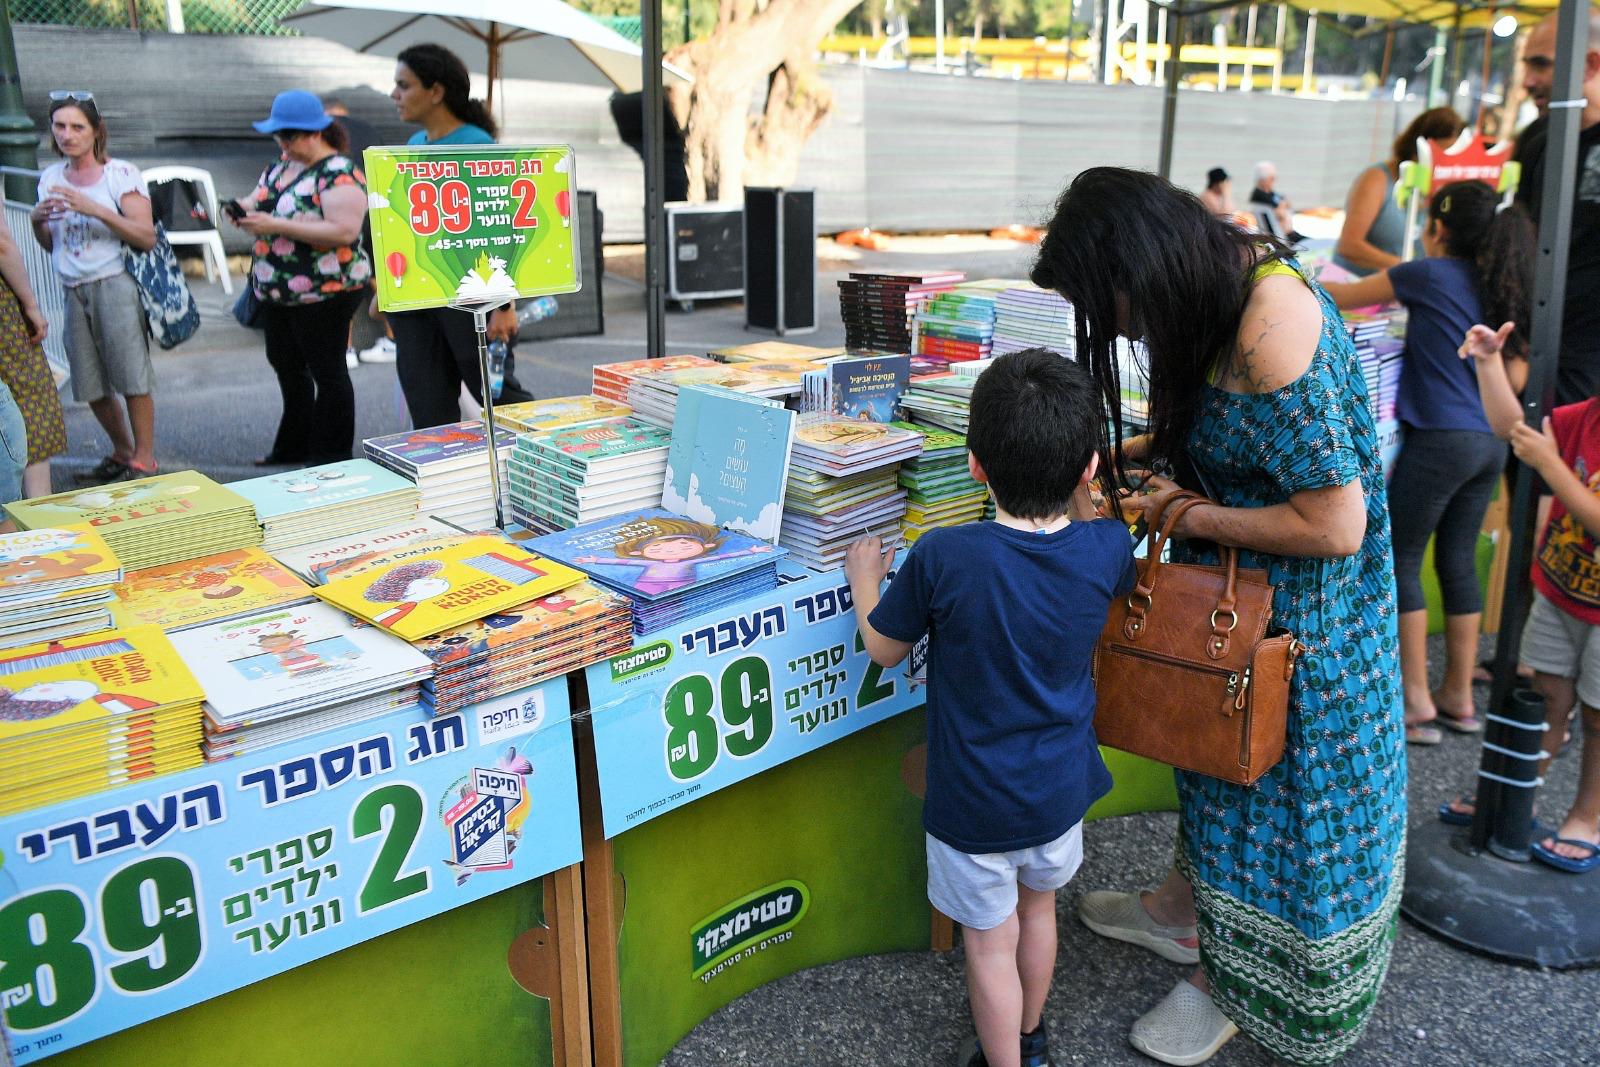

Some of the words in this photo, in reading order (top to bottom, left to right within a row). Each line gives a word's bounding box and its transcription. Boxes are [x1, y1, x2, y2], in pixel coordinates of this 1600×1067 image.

[398, 162, 459, 179] העברי
[464, 160, 516, 176] הספר
[521, 160, 542, 175] חג
[477, 186, 508, 197] ספרי
[511, 179, 538, 229] 2
[475, 199, 509, 212] ילדים
[477, 215, 510, 227] ונוער
[466, 237, 488, 250] נוסף
[491, 235, 511, 245] ספר
[513, 234, 526, 244] כל
[373, 526, 428, 544] מקום
[307, 543, 367, 559] משלי
[438, 584, 512, 609] מטאטא
[795, 585, 854, 623] ספר
[681, 604, 785, 655] העברי
[613, 646, 667, 674] סטימצקי
[788, 644, 845, 675] ספרי
[785, 670, 846, 709] ילדים
[483, 708, 519, 728] חיפה
[790, 698, 847, 733] ונוער
[409, 715, 465, 761] חג
[241, 736, 392, 804] הספר
[687, 784, 701, 796] מתוך
[22, 784, 223, 859] העברי
[230, 829, 334, 874] ספרי
[353, 785, 428, 913] 2
[224, 864, 337, 924] ילדים
[235, 899, 341, 952] ונוער
[697, 894, 794, 958] סטימצקי
[745, 946, 757, 957] זה
[761, 931, 793, 950] ספרים
[701, 953, 742, 983] סטימצקי
[33, 1033, 62, 1049] מתוך
